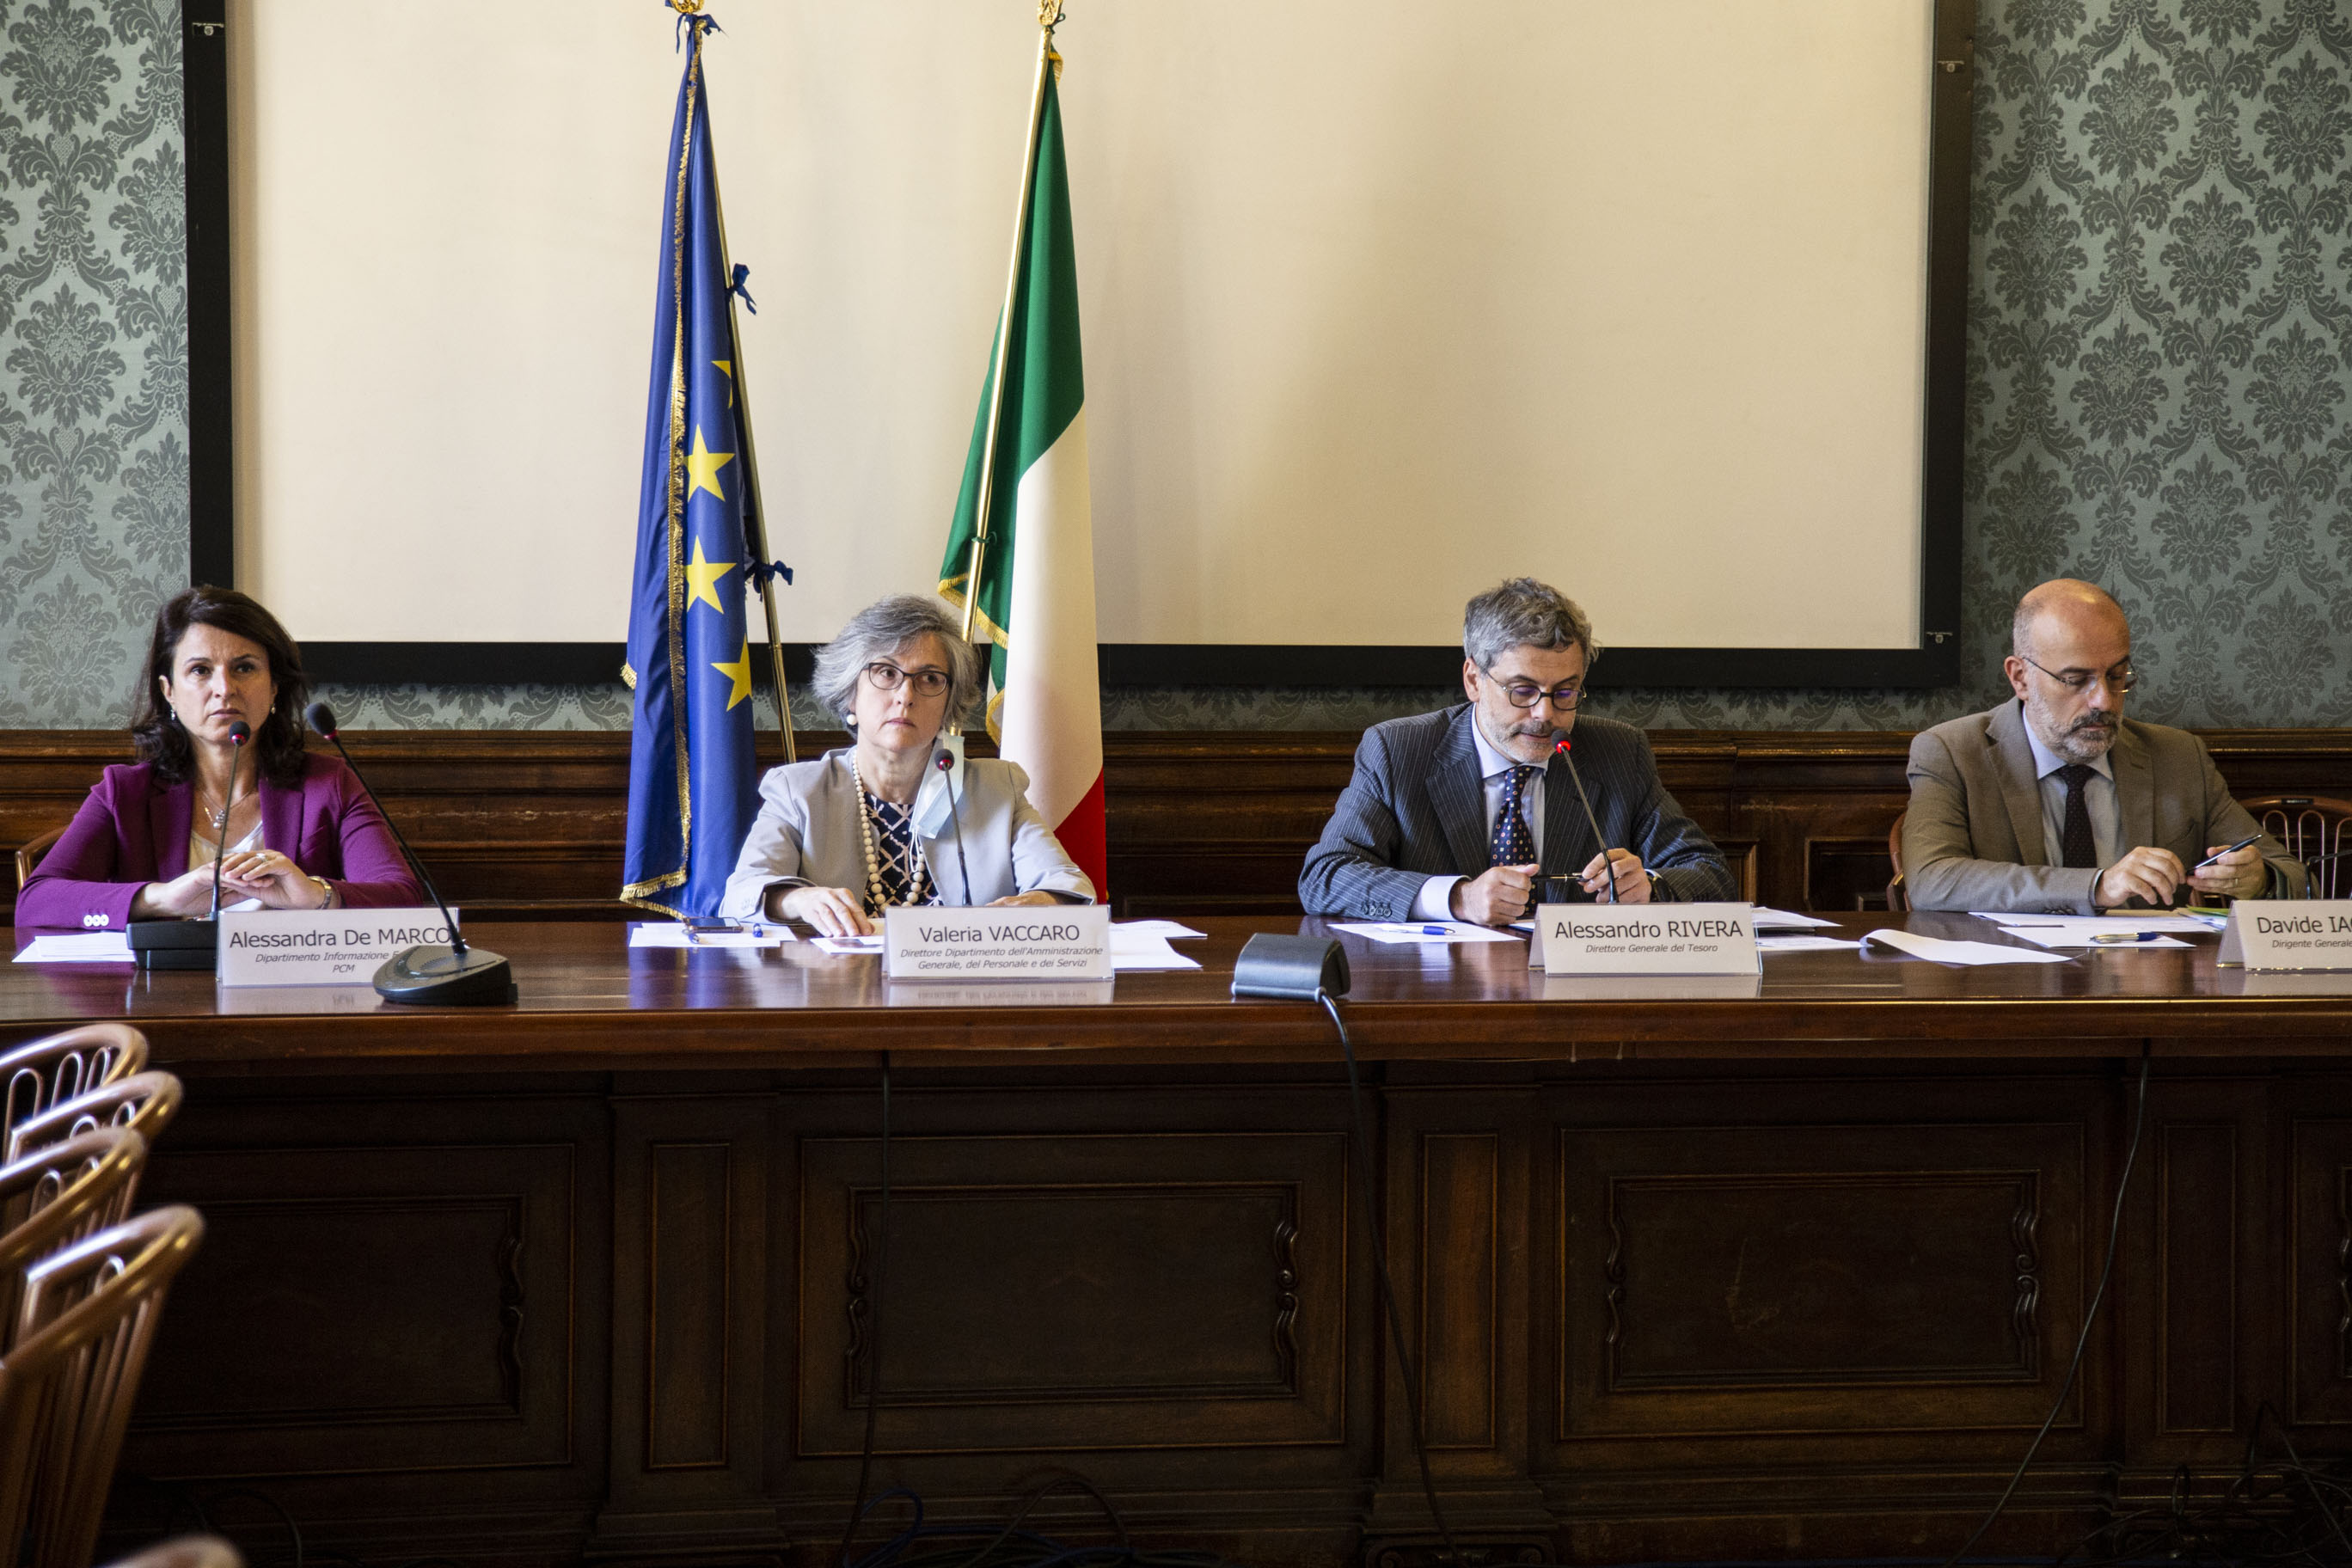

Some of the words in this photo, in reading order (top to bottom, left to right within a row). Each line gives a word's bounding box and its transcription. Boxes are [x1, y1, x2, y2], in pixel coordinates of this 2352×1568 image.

[1555, 921, 1661, 939] Alessandro
[1669, 920, 1743, 937] RIVERA
[2257, 916, 2324, 934] Davide
[2328, 916, 2352, 933] IA
[230, 929, 337, 948] Alessandra
[345, 929, 372, 946] De
[378, 928, 452, 945] MARCO
[919, 926, 983, 942] Valeria
[989, 924, 1081, 941] VACCARO
[1585, 944, 1626, 953] Direttore
[1628, 944, 1669, 952] Generale
[1671, 943, 1685, 952] del
[1688, 943, 1718, 952] Tesoro
[2272, 940, 2312, 950] Dirigente
[254, 952, 321, 964] Dipartimento
[323, 951, 389, 962] Informazione
[900, 948, 942, 958] Direttore
[945, 947, 1006, 959] Dipartimento
[1008, 946, 1104, 957] dell'Amministrazione
[332, 964, 355, 973] PCM
[918, 960, 963, 971] Generale,
[965, 959, 980, 969] del
[983, 959, 1028, 969] Personale
[1039, 959, 1054, 968] dei
[1057, 958, 1087, 967] Servizi
